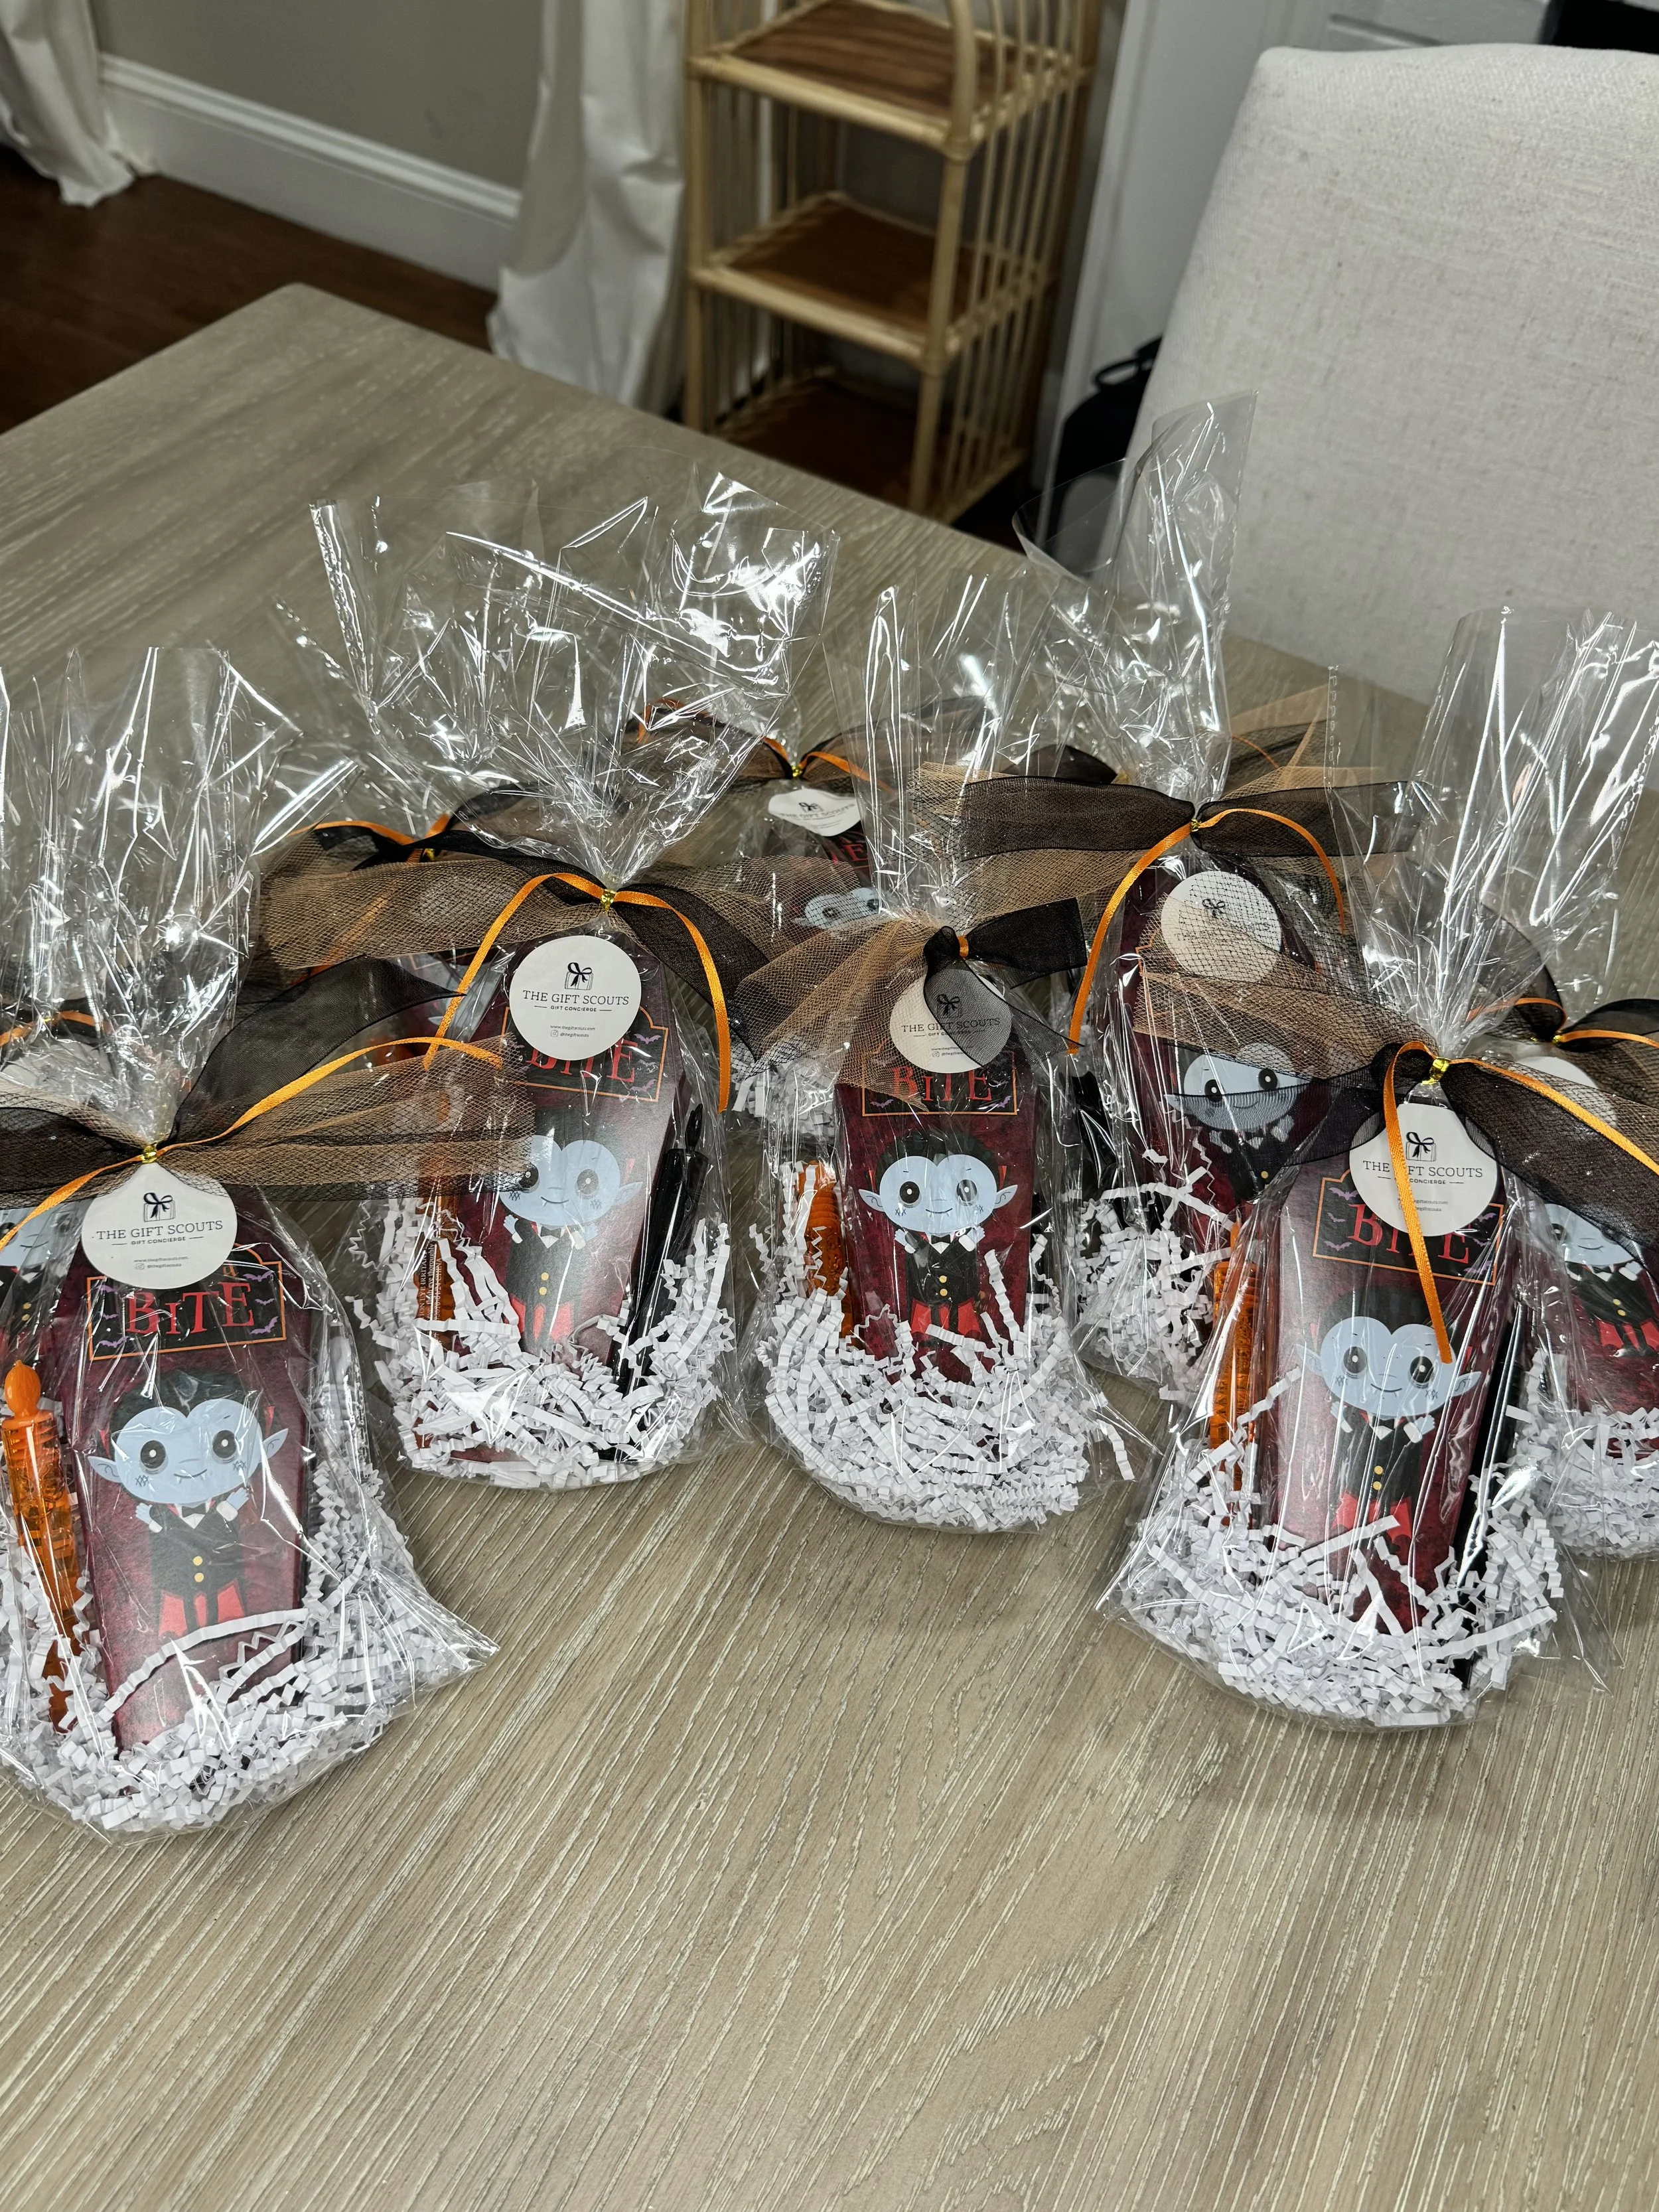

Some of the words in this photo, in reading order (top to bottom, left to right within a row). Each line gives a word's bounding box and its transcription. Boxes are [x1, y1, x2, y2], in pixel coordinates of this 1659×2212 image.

[522, 990, 549, 1001] THE
[551, 994, 580, 1004] GIFT
[582, 995, 630, 1005] SCOUTS
[901, 1024, 925, 1033] THE
[956, 1017, 1001, 1029] SCOUTS
[1362, 1160, 1391, 1173] THE
[1428, 1166, 1484, 1178] SCOUTS
[96, 1228, 126, 1240] THE
[131, 1226, 164, 1238] GIFT
[167, 1220, 224, 1235] SCOUTS
[1348, 1203, 1470, 1264] BIE
[147, 1236, 186, 1244] CONCIERGE
[427, 1244, 435, 1276] thoroughly
[125, 1281, 255, 1335] BITE
